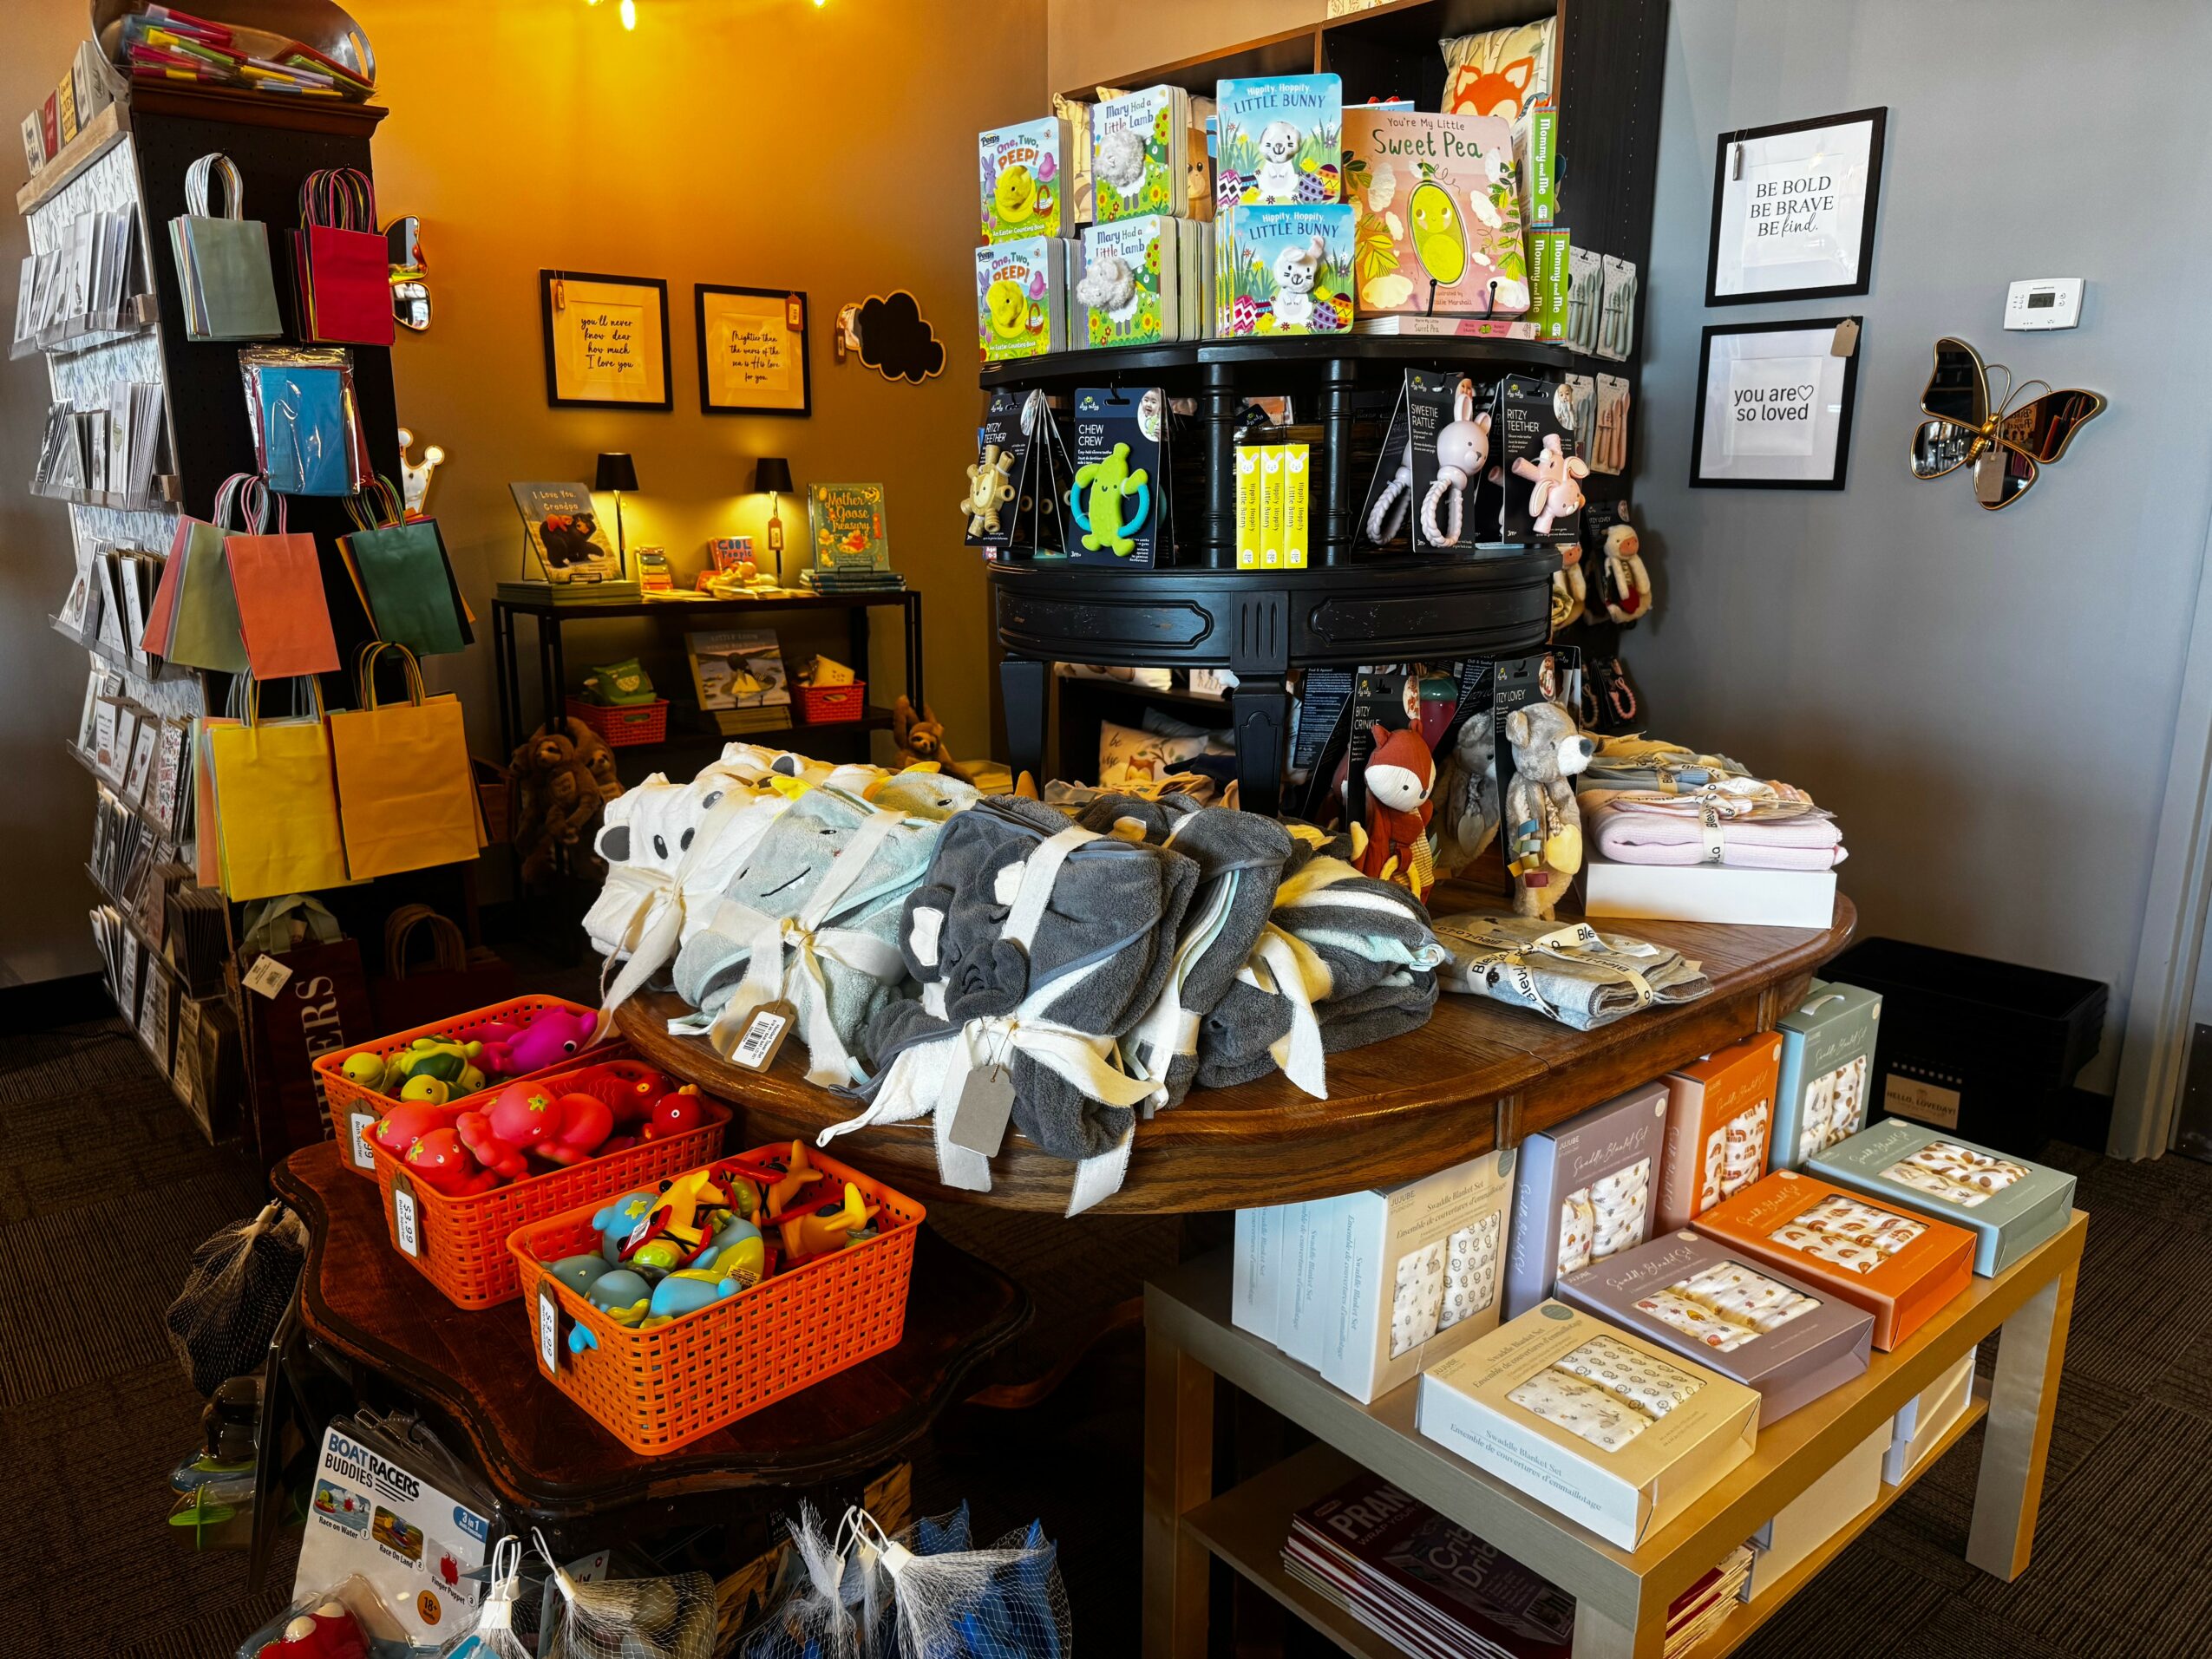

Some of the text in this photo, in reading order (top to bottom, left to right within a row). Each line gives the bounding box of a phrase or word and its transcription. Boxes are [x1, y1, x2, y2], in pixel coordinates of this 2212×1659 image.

[1106, 104, 1129, 118] Mary
[1131, 98, 1145, 112] Had
[1234, 94, 1325, 114] LITTLE BUNNY
[1104, 109, 1154, 135] Little Lamb
[1388, 117, 1465, 130] You're My Little
[981, 134, 999, 147] Peeps
[997, 135, 1038, 154] One, Two,
[1372, 128, 1483, 159] Sweet Pea
[1535, 119, 1551, 162] Mommy
[998, 147, 1039, 170] PEEP!
[1538, 176, 1549, 195] Me
[1757, 176, 1831, 198] BE BOLD
[1751, 195, 1834, 219] BE BRAVE
[1249, 223, 1339, 240] LITTLE BUNNY
[1757, 212, 1818, 238] BE kind.
[1097, 231, 1120, 245] Mary
[1122, 228, 1136, 238] Had
[978, 250, 994, 261] Peeps
[1096, 241, 1145, 258] Little Lamb
[991, 251, 1030, 270] One, Two,
[1530, 239, 1545, 282] Mommy
[1550, 239, 1565, 282] Mommy
[992, 265, 1031, 282] PEEP!
[1533, 296, 1543, 313] Me
[1553, 296, 1563, 313] Me
[580, 315, 607, 330] you'll
[585, 329, 632, 341] know dear
[587, 342, 630, 354] how much
[730, 345, 741, 354] the
[769, 346, 781, 356] the
[586, 354, 633, 372] I love you
[768, 358, 781, 369] love
[1734, 385, 1796, 407] you are
[1411, 404, 1438, 417] SWEETIE
[1507, 409, 1527, 420] RITZY
[1737, 403, 1808, 421] so loved
[985, 422, 1001, 433] RITZY
[1078, 424, 1104, 434] CHEW
[1412, 416, 1435, 428] RATTLE
[1507, 421, 1539, 432] TEETHER
[985, 432, 1006, 443] TEETHER
[1078, 436, 1103, 446] CREW
[543, 502, 579, 512] Grandpa
[825, 493, 867, 509] Mother
[836, 506, 869, 522] Goose
[833, 520, 870, 532] Treasury
[718, 539, 751, 550] COOL
[723, 551, 751, 559] People
[1496, 689, 1527, 703] ITZY LOVEY
[1356, 706, 1371, 717] BITZY
[1391, 1190, 1416, 1206] JUJUBE
[1427, 1196, 1451, 1212] Swaddle
[1452, 1185, 1473, 1199] Blanket
[1474, 1181, 1483, 1190] Set
[403, 1205, 413, 1244] $3.99
[1397, 1220, 1425, 1238] Ensemble
[1426, 1217, 1436, 1226] de
[1436, 1203, 1469, 1223] couvertures
[1299, 1225, 1306, 1234] de
[1341, 1214, 1355, 1304] Ensemble de couvertures
[1353, 1257, 1364, 1288] Swaddle
[1487, 1346, 1515, 1362] Swaddle
[1434, 1358, 1459, 1375] JUJUBE
[1473, 1343, 1546, 1388] Ensemble de couvertures
[1450, 1423, 1484, 1447] Ensemble
[1486, 1443, 1495, 1453] de
[1496, 1450, 1541, 1478] couvertures
[1485, 1430, 1561, 1476] Swaddle Blanket Set
[325, 1453, 373, 1488] BUDDIES
[329, 1433, 420, 1499] BOAT RACERS
[318, 1516, 332, 1528] Race
[341, 1526, 358, 1539] Water
[462, 1512, 467, 1521] 3
[475, 1521, 479, 1531] 1
[1358, 1507, 1414, 1545] WRAP YOUR
[380, 1544, 391, 1556] Race
[400, 1556, 413, 1569] Land
[431, 1576, 466, 1604] Finger Puppet
[423, 1597, 437, 1612] 18+
